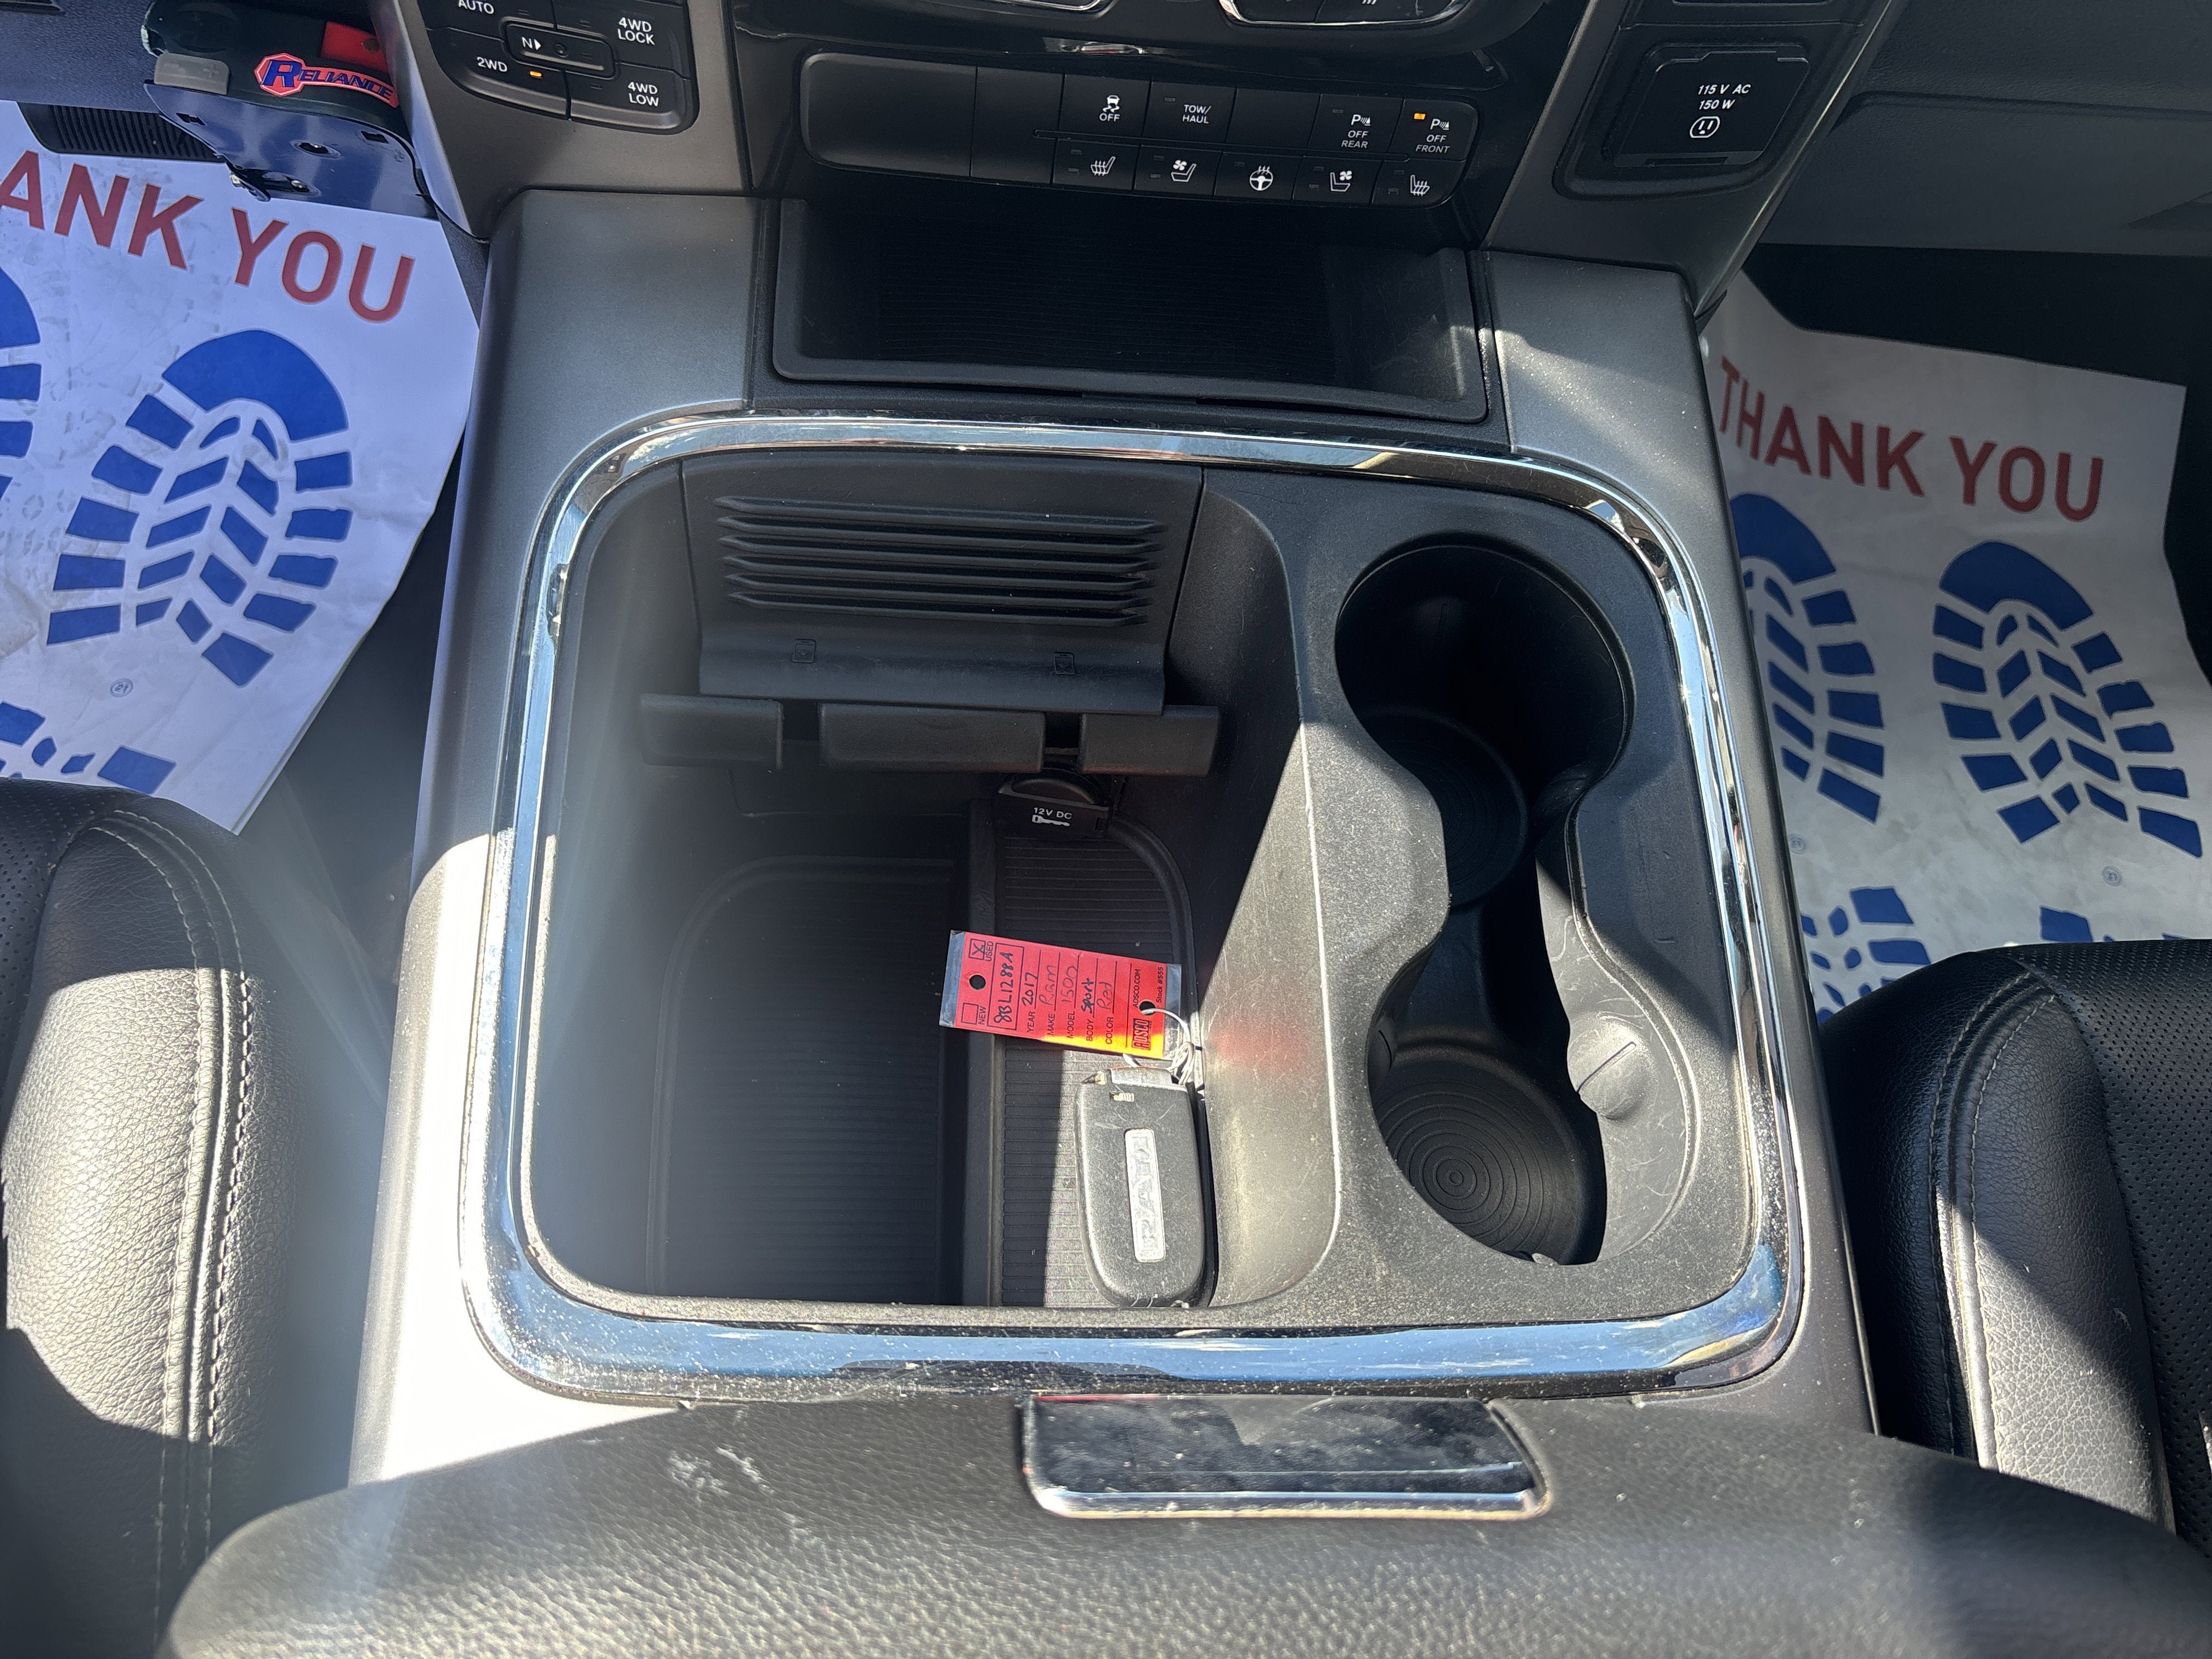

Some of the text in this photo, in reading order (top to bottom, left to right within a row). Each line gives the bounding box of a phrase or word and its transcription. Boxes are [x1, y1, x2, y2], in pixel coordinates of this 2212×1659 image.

[458, 0, 494, 15] AUTO
[618, 17, 652, 32] 4WD
[521, 36, 533, 49] N
[618, 28, 655, 46] LOCK
[477, 57, 507, 73] 2WD
[261, 60, 393, 98] RELIANCE
[628, 81, 658, 95] 4WD
[1698, 84, 1751, 94] 115 V AC
[628, 93, 659, 107] LOW
[1699, 99, 1735, 110] 150 W
[1183, 104, 1212, 115] TOW/
[1099, 113, 1120, 122] OFF
[1182, 114, 1209, 123] HAUL
[1347, 130, 1369, 138] OFF
[1426, 134, 1447, 143] OFF
[1341, 140, 1368, 149] REAR
[1415, 144, 1450, 153] FRONT
[0, 150, 416, 323] ANK YOU
[1719, 355, 2104, 522] THANK YOU
[1033, 807, 1072, 820] 12V DC
[985, 941, 994, 962] USED
[1132, 969, 1141, 1008] ADSCO.COM
[1022, 972, 1039, 1032] YEAR 2017
[1039, 964, 1056, 1036] MAKE Ram
[1060, 966, 1078, 1039] MODEL 1500
[978, 1006, 986, 1025] NEW
[1097, 981, 1114, 1045] COLOR Red
[1132, 1019, 1150, 1050] ADSCO
